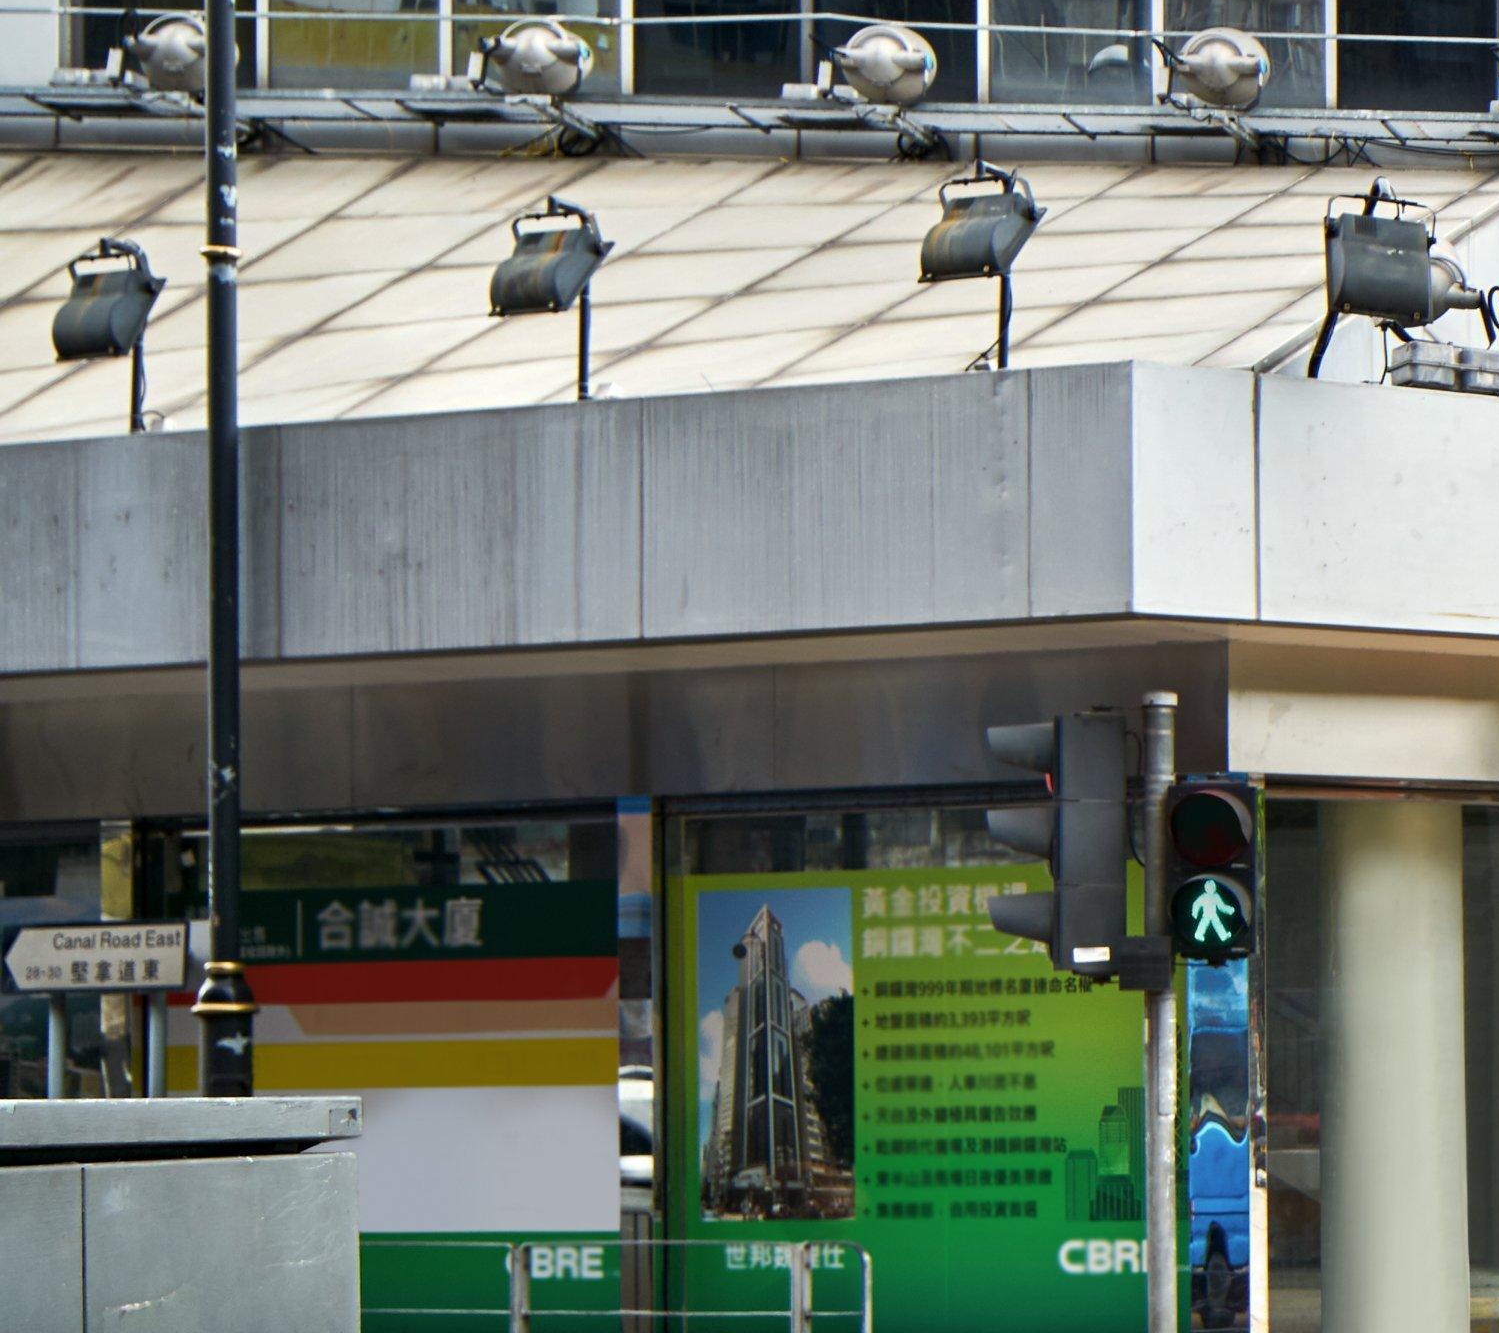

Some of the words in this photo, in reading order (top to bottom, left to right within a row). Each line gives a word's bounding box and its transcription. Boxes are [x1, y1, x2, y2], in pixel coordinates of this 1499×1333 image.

[53, 933, 96, 950] Canal
[101, 931, 141, 949] Road
[145, 929, 182, 949] East
[317, 896, 484, 951] 合誠大廈
[505, 1245, 604, 1279] BRE
